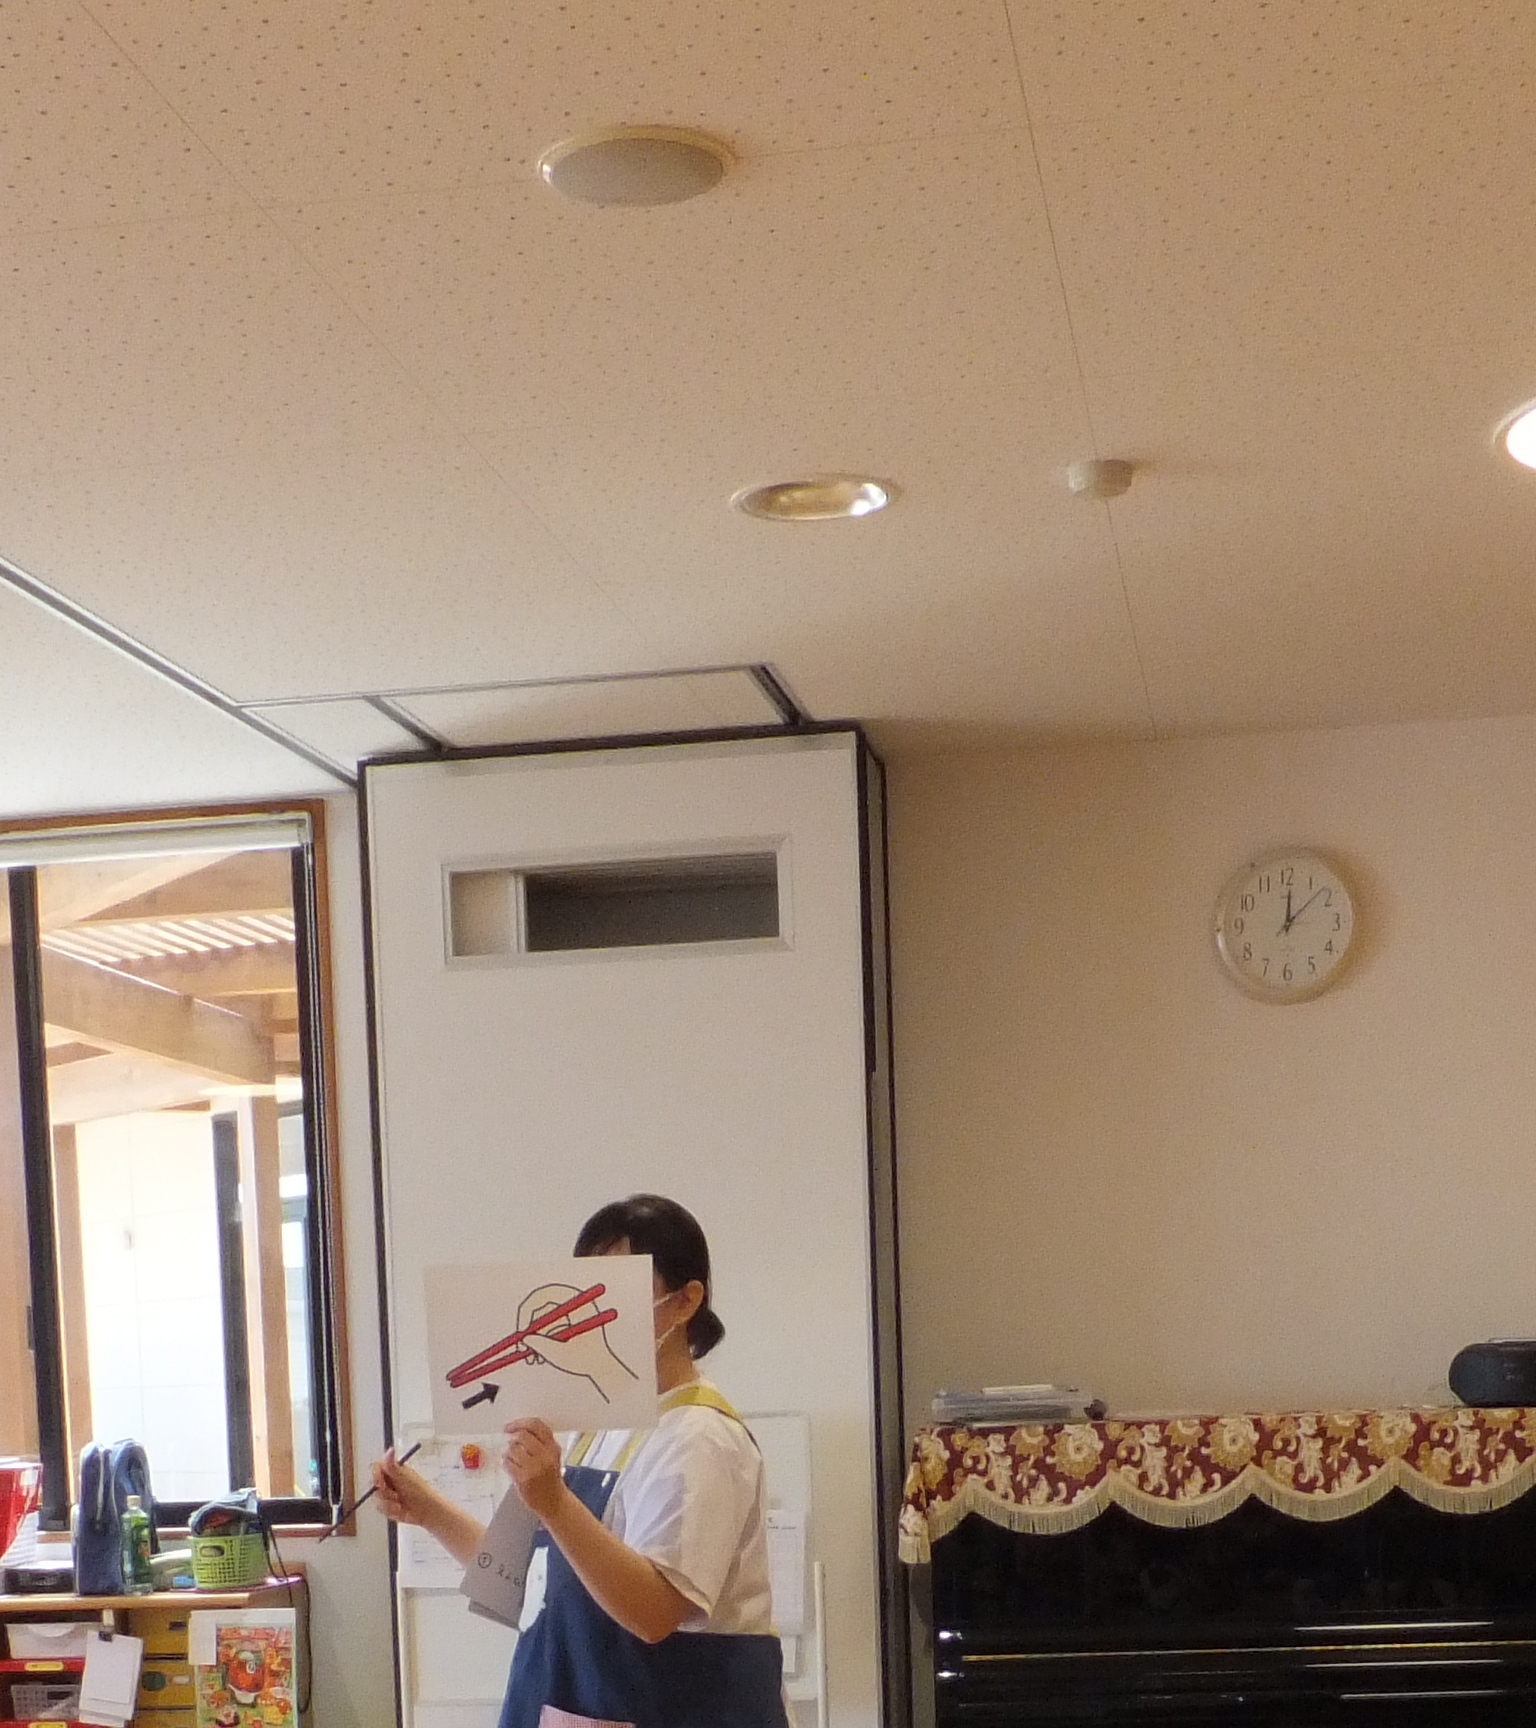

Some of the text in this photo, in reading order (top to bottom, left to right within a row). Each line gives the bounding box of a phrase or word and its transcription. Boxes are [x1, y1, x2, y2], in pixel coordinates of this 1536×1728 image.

[1258, 875, 1271, 893] 11
[1280, 867, 1294, 886] 12
[1240, 893, 1255, 912] 10
[1322, 887, 1332, 907] 2
[1234, 917, 1245, 937] 9
[1332, 913, 1341, 932] 3
[1243, 942, 1253, 961] 8
[1324, 939, 1333, 955] 4
[1262, 958, 1270, 976] 7
[1282, 962, 1293, 981] 6
[1307, 956, 1316, 974] 5
